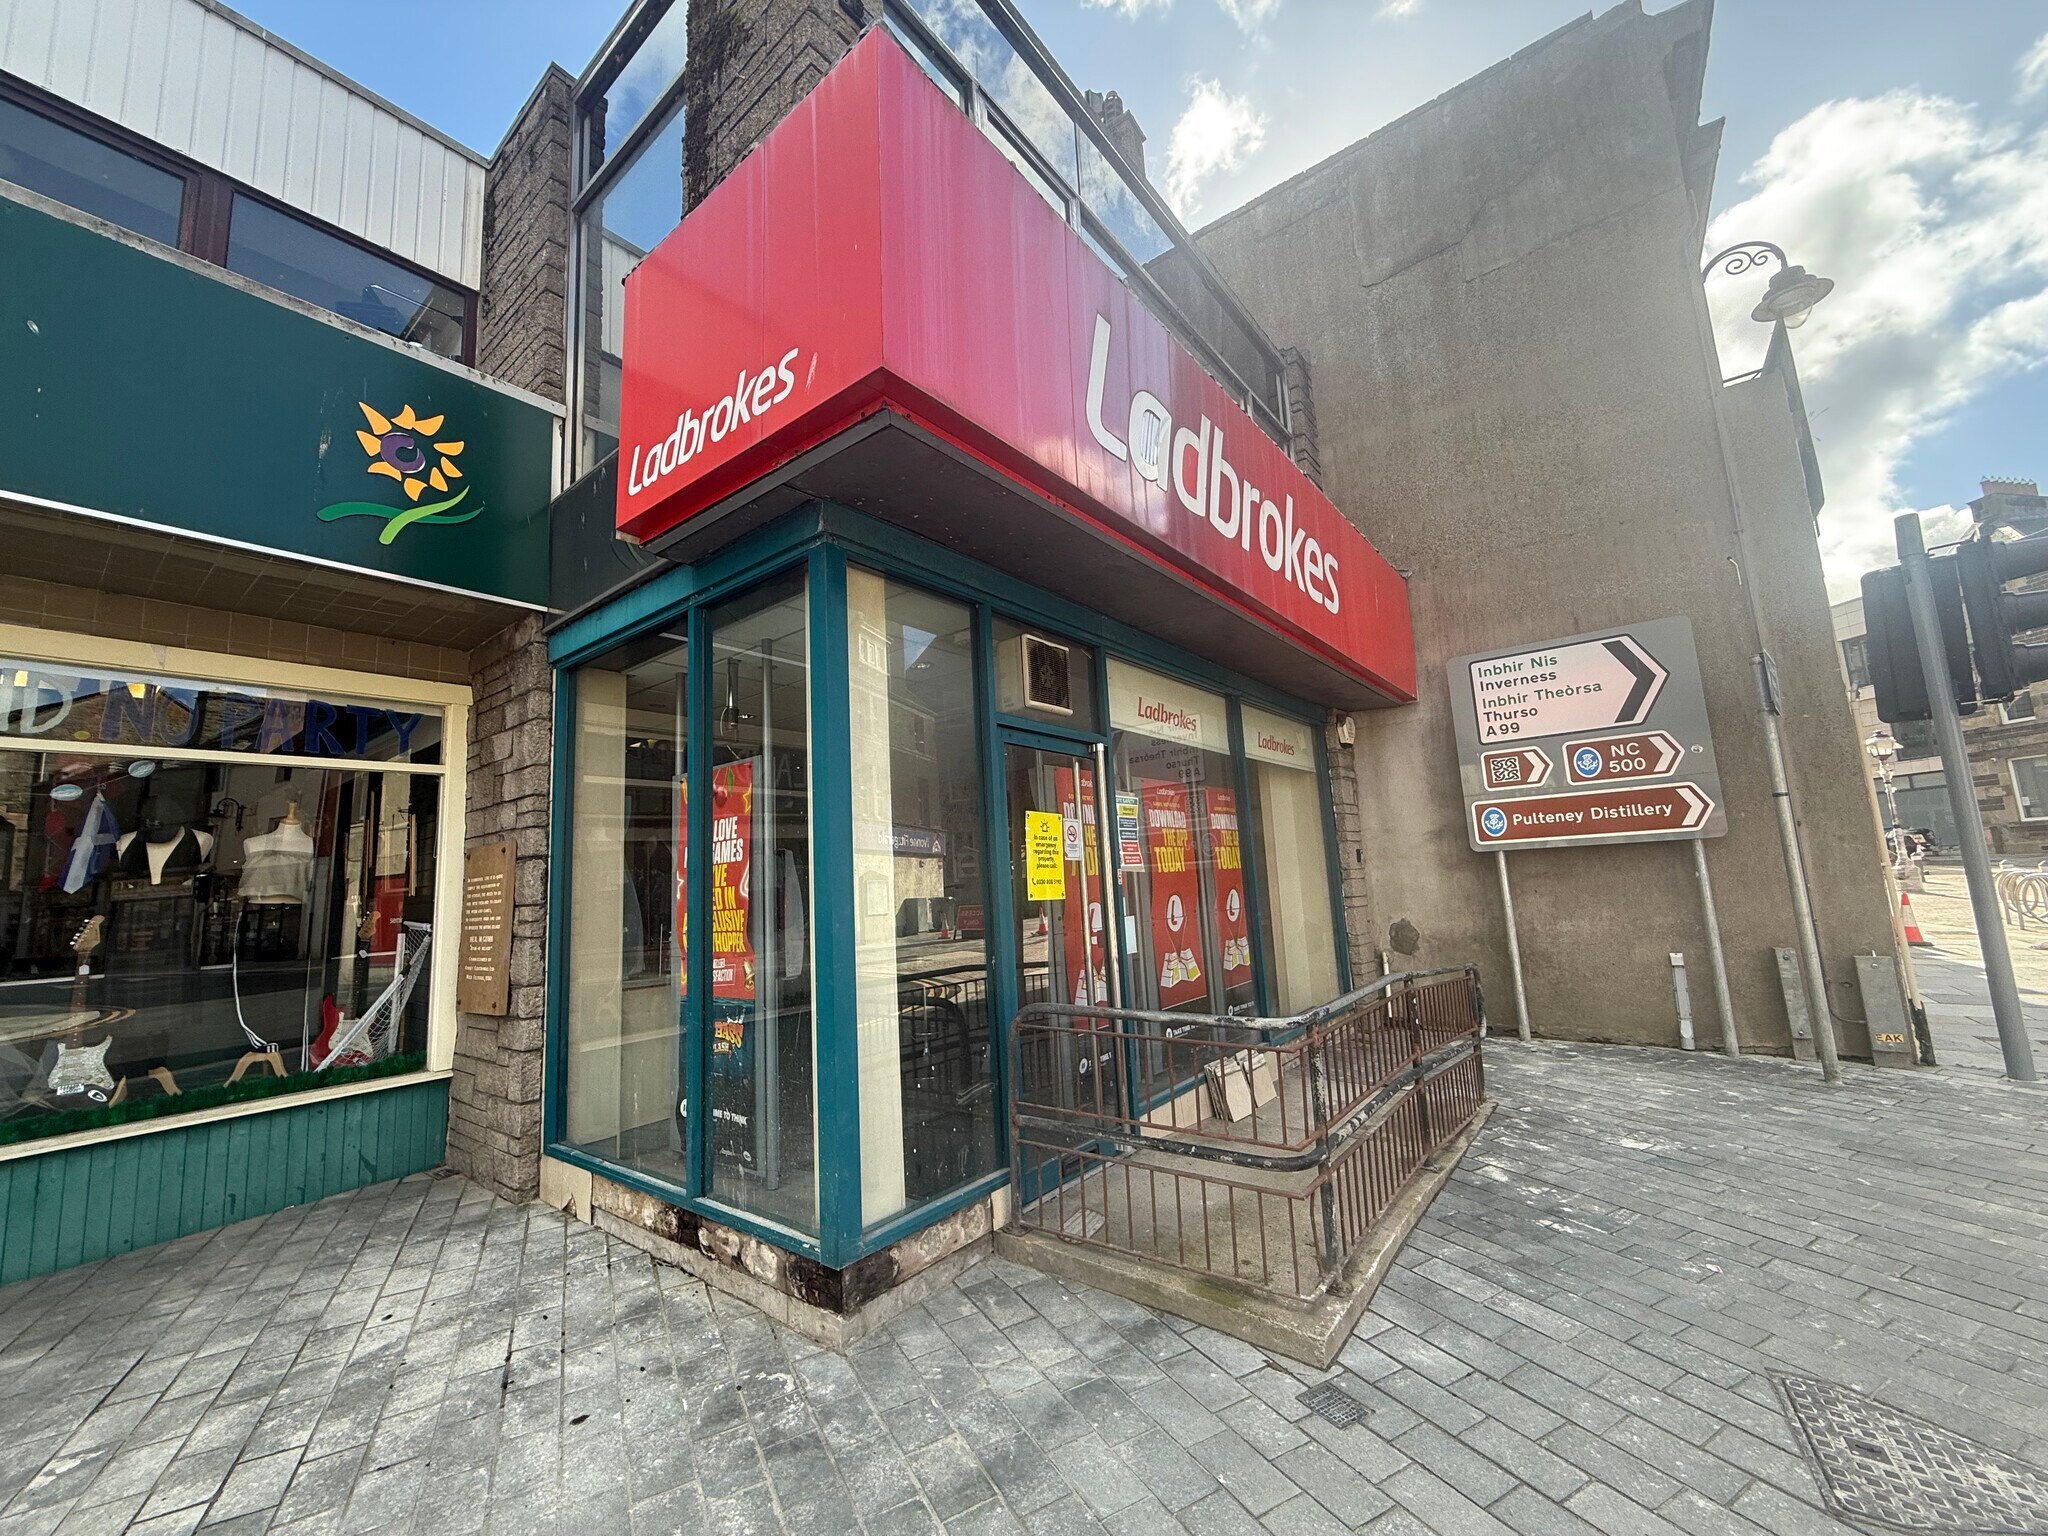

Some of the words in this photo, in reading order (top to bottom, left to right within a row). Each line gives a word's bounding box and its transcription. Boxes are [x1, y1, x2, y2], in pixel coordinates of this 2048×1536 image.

[628, 347, 799, 497] Ladbrokes
[1086, 312, 1340, 615] Ladbrokes
[1478, 661, 1523, 678] Inbhir
[1530, 655, 1558, 669] Nis
[1480, 671, 1557, 692] Inverness
[1482, 692, 1529, 709] Inbhir
[1533, 682, 1603, 701] Theòrsa
[101, 677, 197, 747] NO
[221, 692, 424, 757] PARTY
[1137, 696, 1197, 732] Ladbrokes
[1483, 707, 1539, 723] Thurso
[1257, 731, 1295, 756] Ladbrokes
[1610, 742, 1640, 757] NC
[1609, 757, 1646, 773] 500
[1148, 808, 1187, 829] DOWNLOAD
[1512, 811, 1584, 827] Pulteney
[1590, 803, 1673, 821] Distillery
[713, 816, 738, 842] LOVE
[1162, 828, 1176, 847] THE
[1154, 847, 1185, 873] TODAY
[724, 886, 737, 910] IN
[715, 1022, 744, 1049] BASS
[724, 1110, 731, 1121] TO
[731, 1112, 749, 1126] THINK
